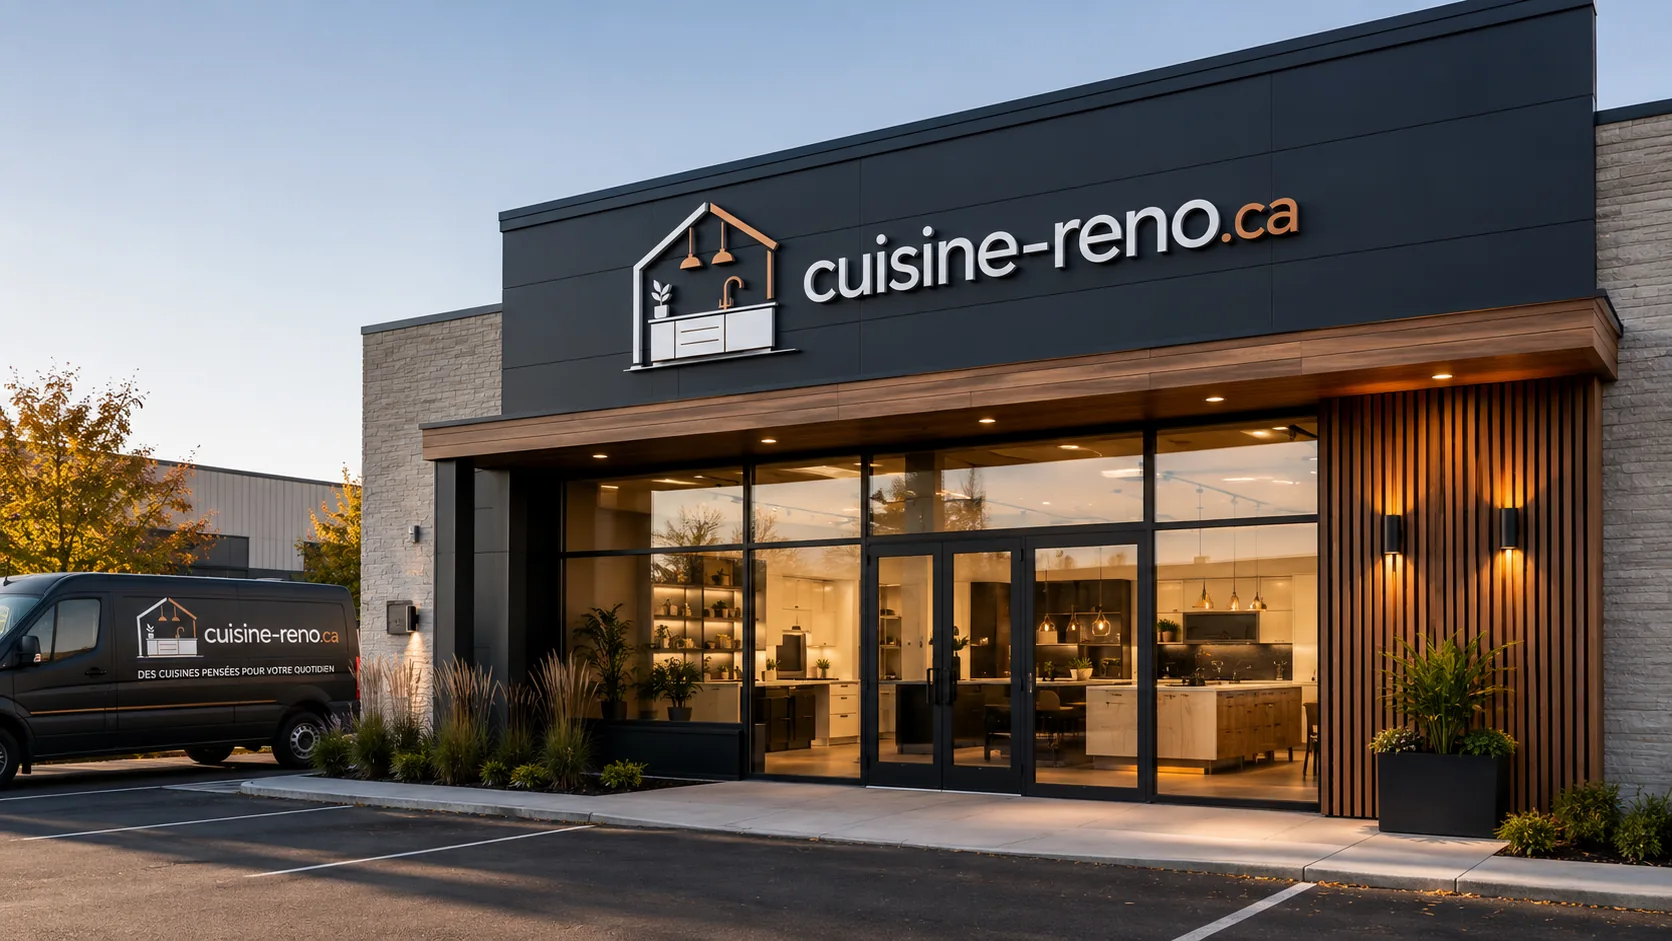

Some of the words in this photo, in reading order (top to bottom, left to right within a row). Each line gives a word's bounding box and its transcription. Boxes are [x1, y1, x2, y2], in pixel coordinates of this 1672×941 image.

[803, 196, 1300, 304] cuisine-reno.ca
[204, 623, 339, 644] cuisine-reno.ca
[138, 670, 157, 679] DES
[158, 668, 200, 679] CUISINES
[202, 665, 240, 677] PENSÉES
[242, 667, 265, 676] POUR
[267, 666, 293, 675] VOTRE
[294, 665, 335, 675] QUOTIDIEN
